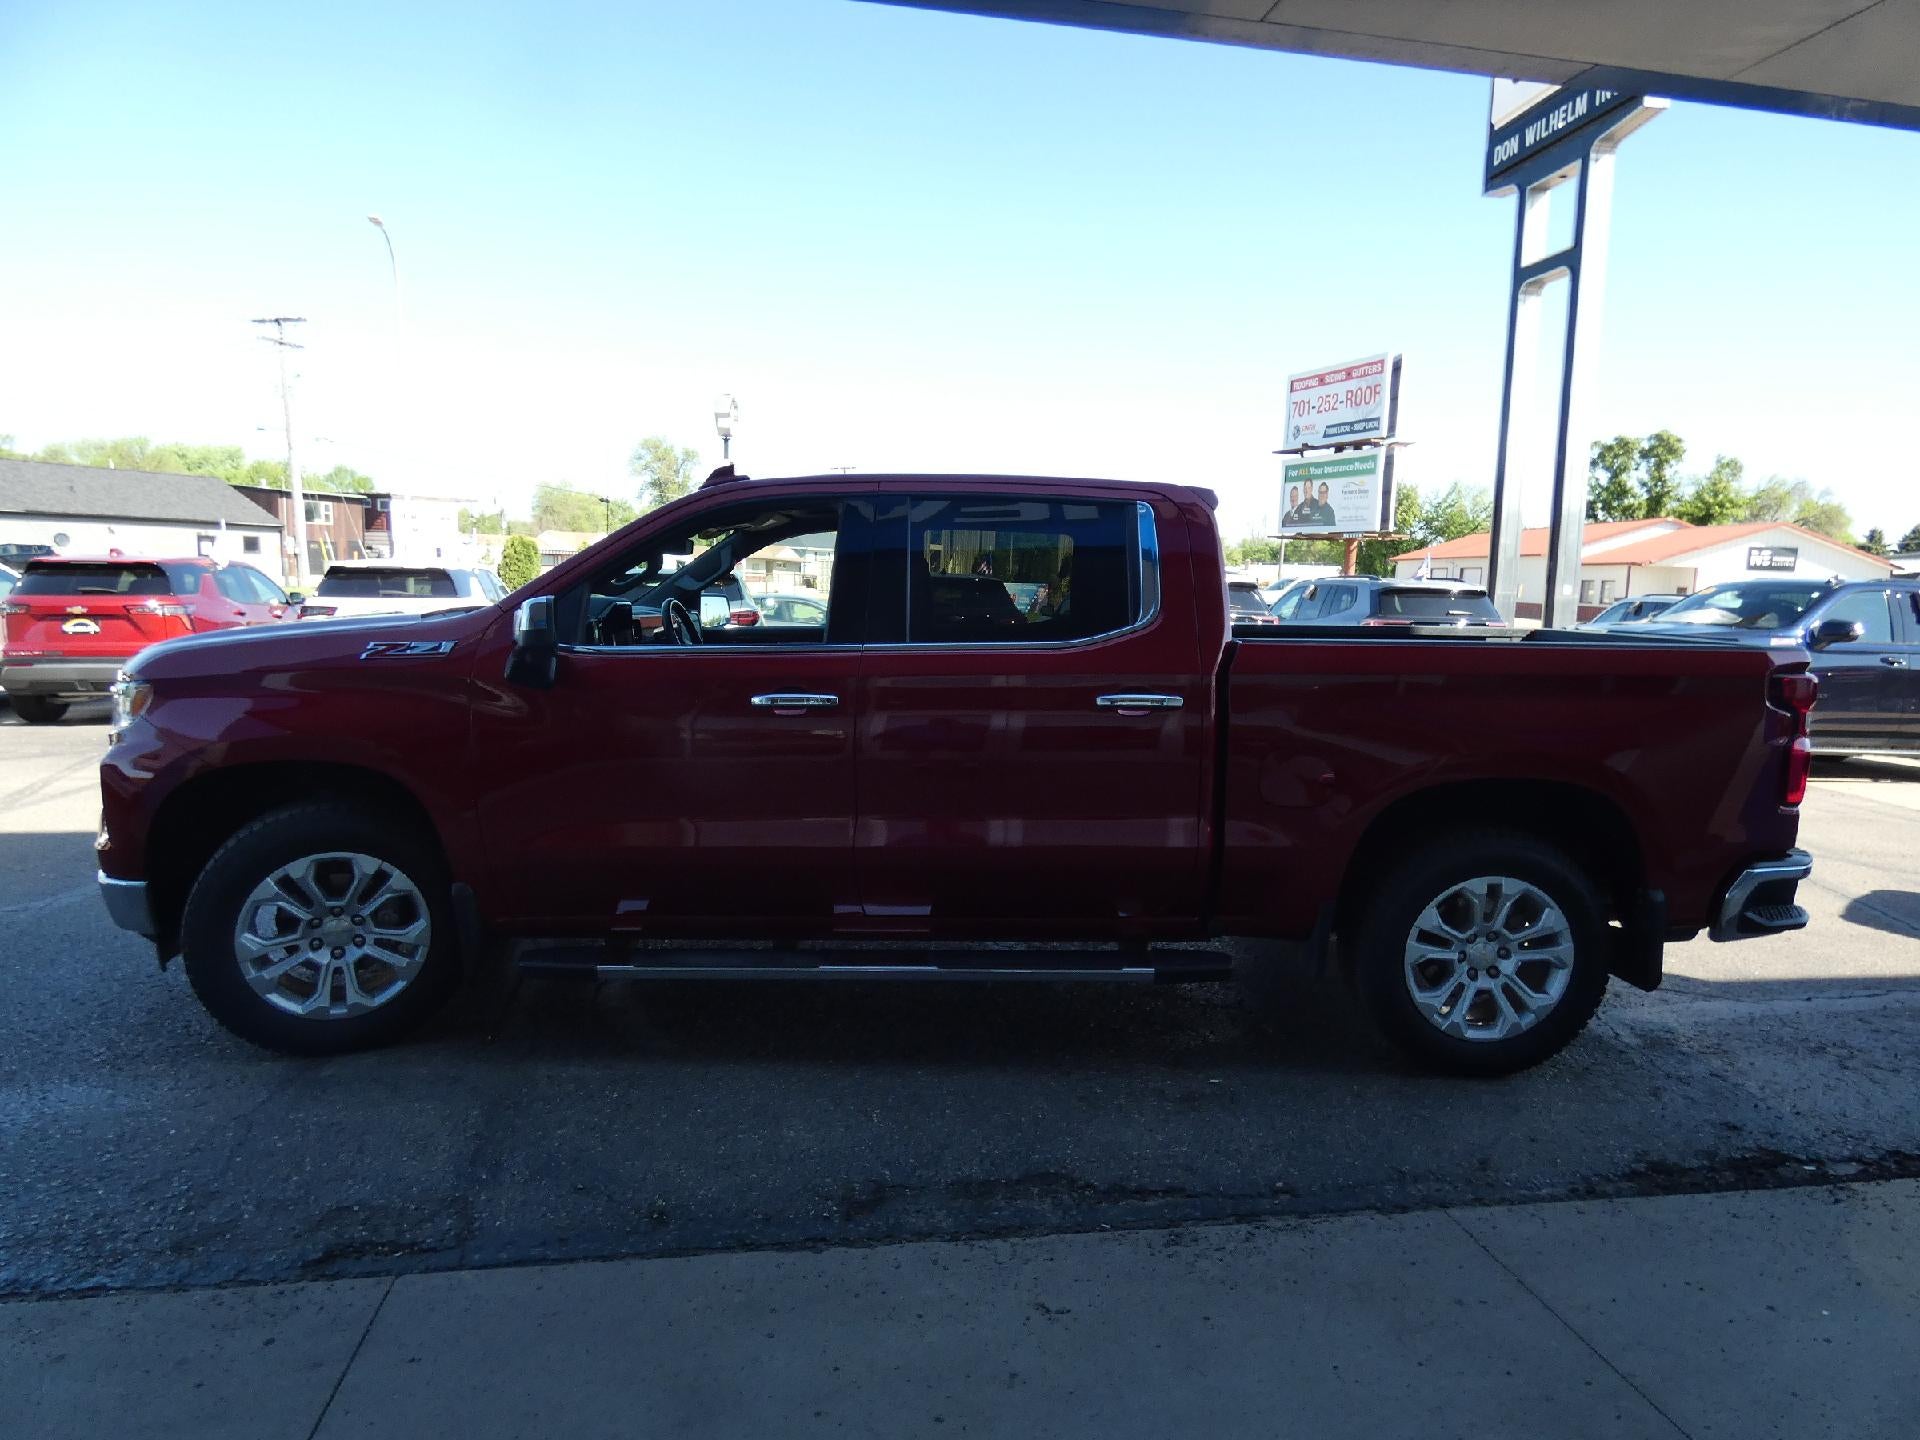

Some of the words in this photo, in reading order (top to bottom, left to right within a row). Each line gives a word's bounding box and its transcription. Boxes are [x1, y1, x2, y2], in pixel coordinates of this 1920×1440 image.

[1493, 133, 1519, 167] DON
[1525, 91, 1588, 147] WILHELM
[1293, 378, 1318, 390] ROOFING
[1325, 371, 1346, 384] SIDING
[1352, 364, 1381, 376] GUTTERS
[1292, 383, 1381, 419] 701-252-ROOF
[1288, 469, 1299, 478] For
[1299, 468, 1309, 476] ALL
[1309, 466, 1323, 476] Your
[1324, 463, 1354, 474] Insurance
[1354, 459, 1375, 471] Needs
[360, 640, 459, 660] Z71
